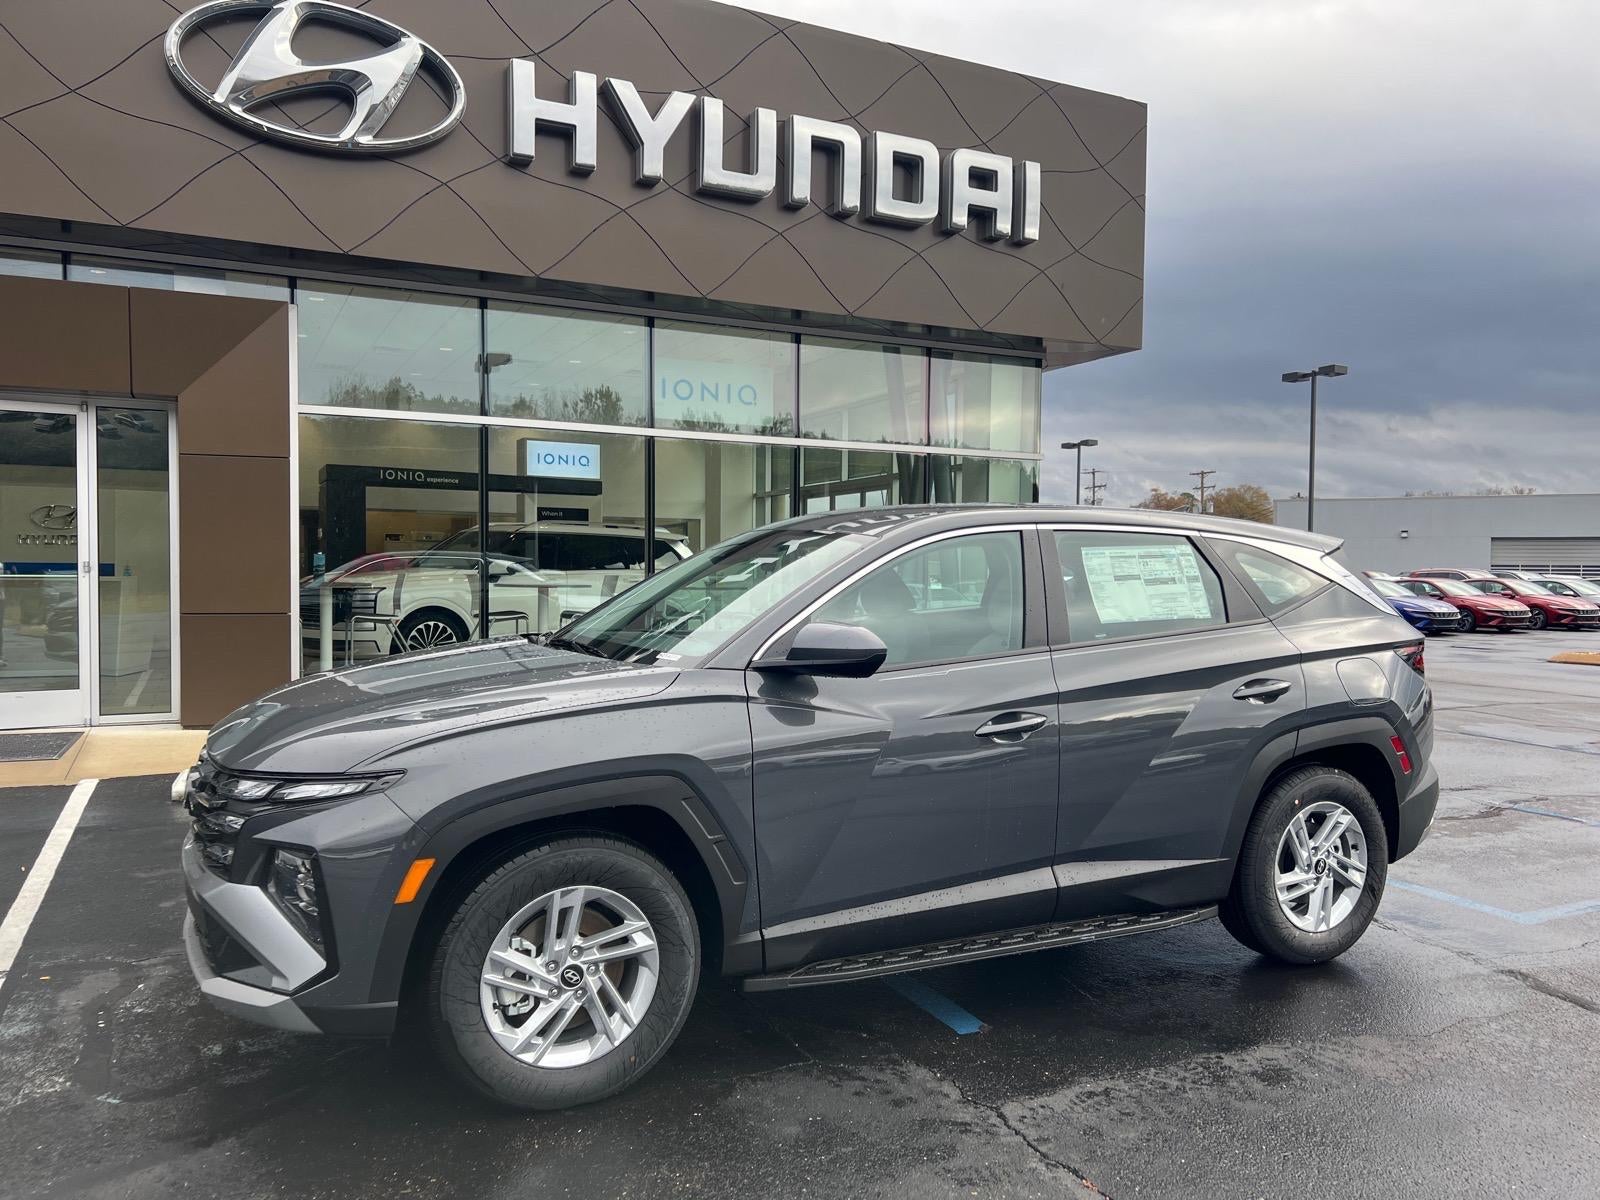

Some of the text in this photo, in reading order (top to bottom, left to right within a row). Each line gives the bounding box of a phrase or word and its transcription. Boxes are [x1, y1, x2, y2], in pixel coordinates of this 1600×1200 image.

[506, 57, 1041, 244] HYUNDAI
[661, 377, 757, 406] IONIQ
[536, 453, 590, 467] IONIQ
[379, 469, 425, 482] IONIQ
[17, 534, 77, 545] HYUND
